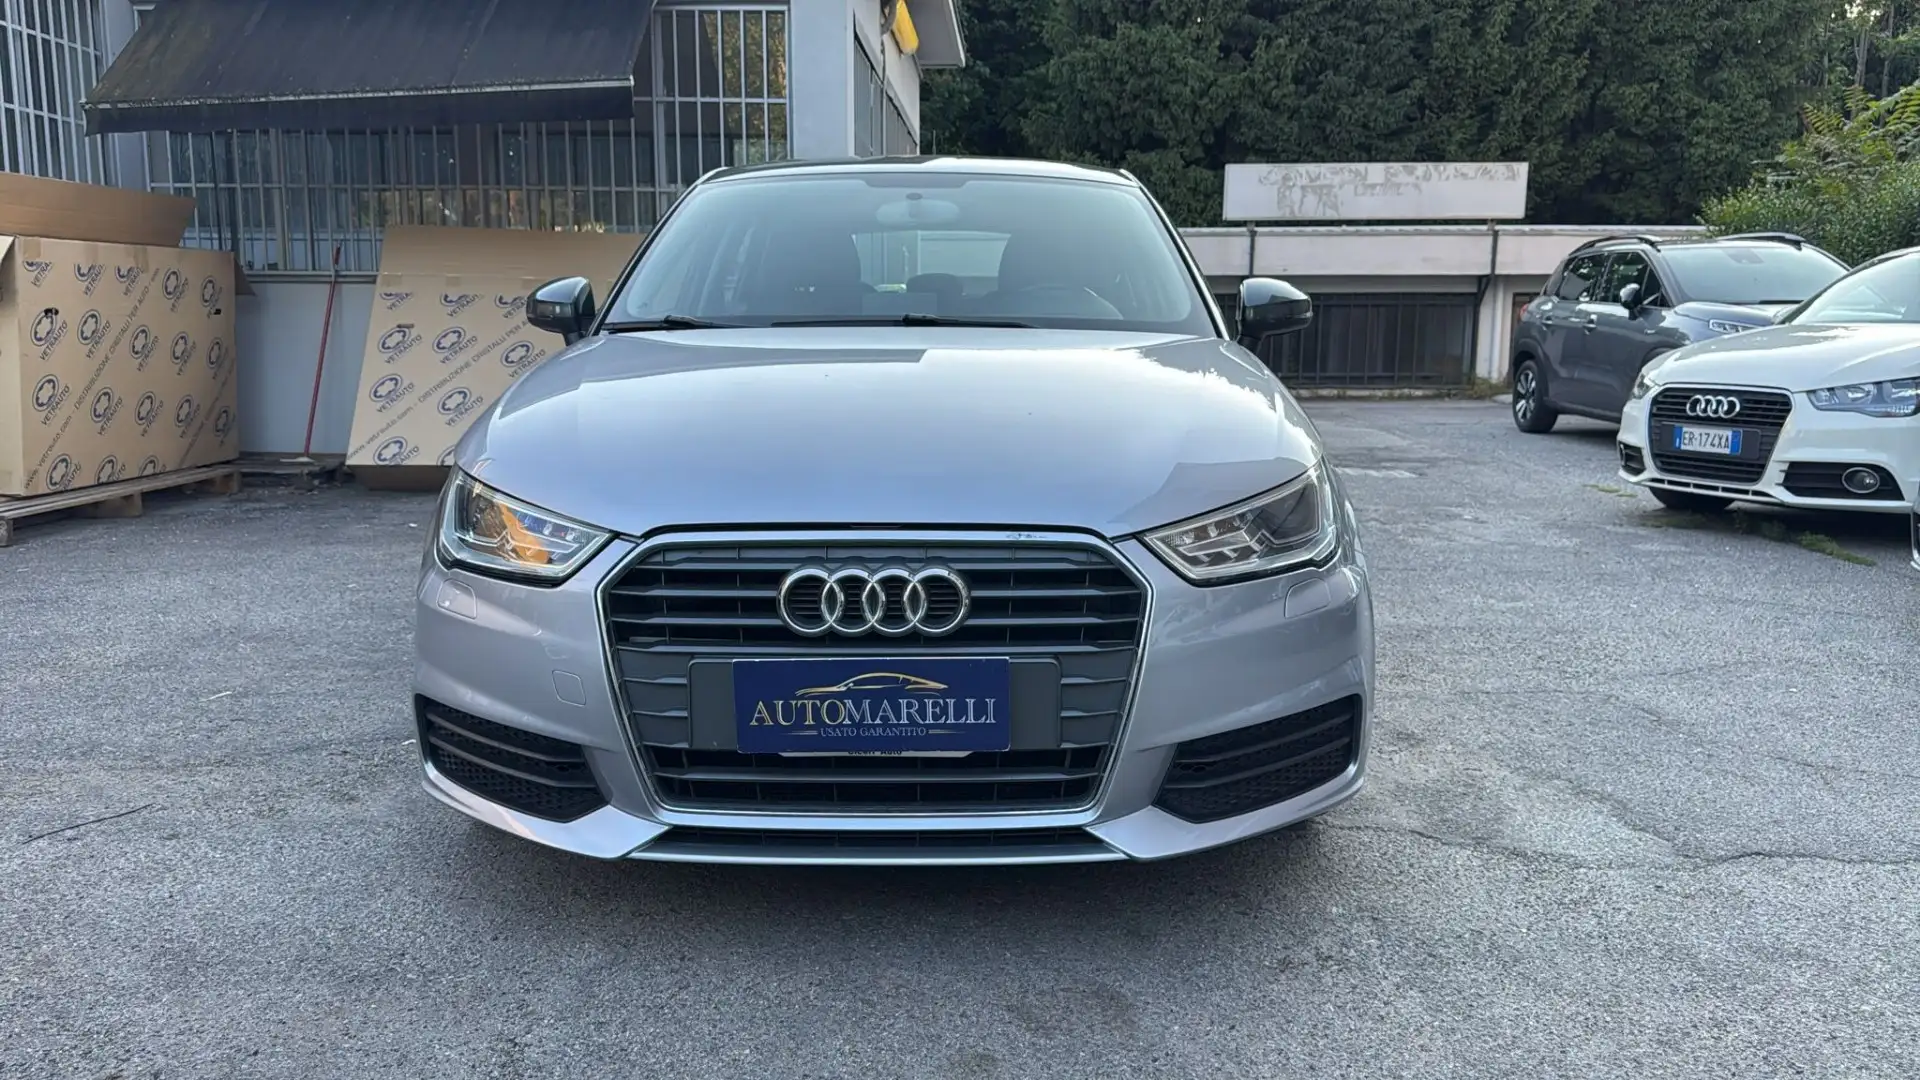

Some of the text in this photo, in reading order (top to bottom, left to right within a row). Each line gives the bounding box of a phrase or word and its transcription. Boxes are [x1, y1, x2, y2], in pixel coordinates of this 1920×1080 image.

[30, 262, 50, 286] VETRA
[386, 292, 411, 310] VETRA
[39, 320, 68, 361] VETRAUTO
[85, 320, 111, 359] VETRAUTO
[385, 334, 422, 364] VETRAUTO
[440, 335, 478, 364] VETRAUTO
[509, 348, 546, 378] VETRAUTO
[41, 385, 70, 425] VETRAUTO
[376, 382, 415, 413] VETRAUTO
[445, 395, 484, 427] VETRAUTO
[97, 396, 123, 436] VETRAUTO
[749, 697, 997, 726] AUTOMARELLI
[820, 726, 927, 737] USATO GARANTITO
